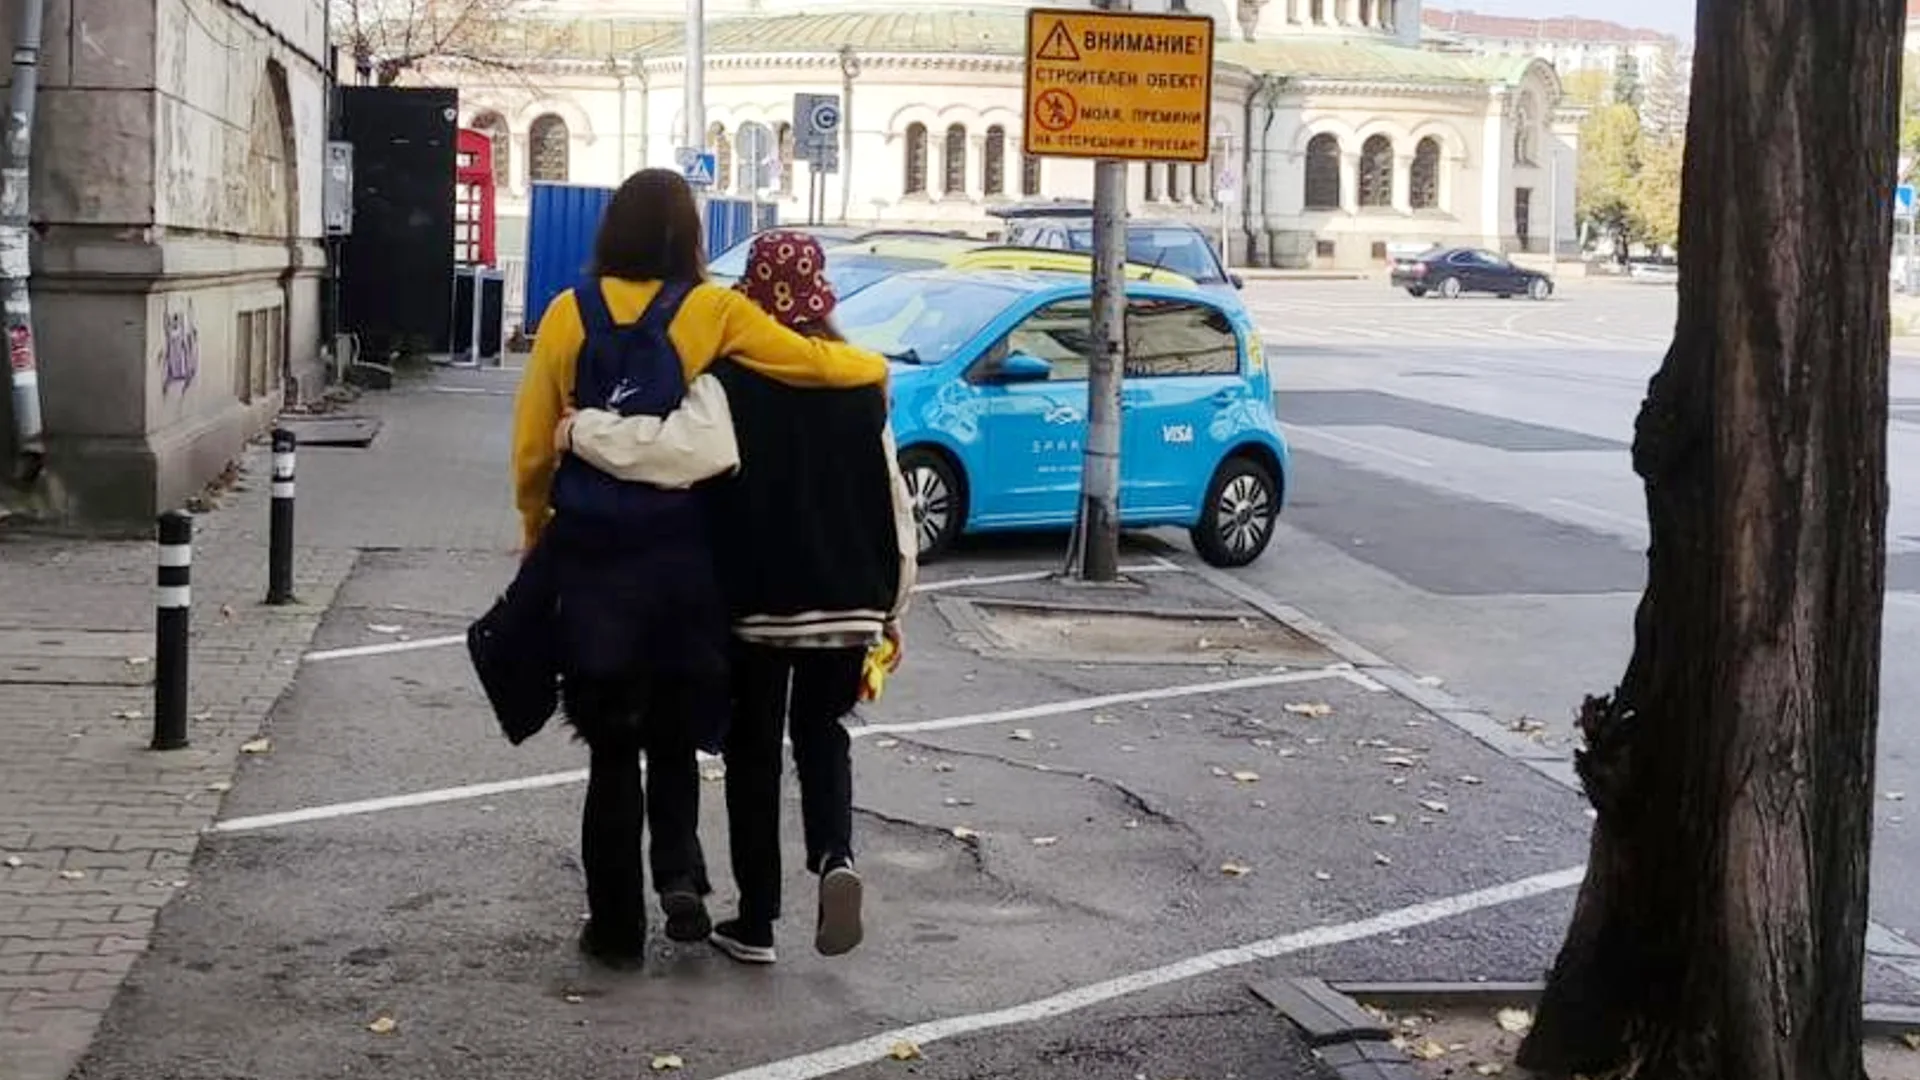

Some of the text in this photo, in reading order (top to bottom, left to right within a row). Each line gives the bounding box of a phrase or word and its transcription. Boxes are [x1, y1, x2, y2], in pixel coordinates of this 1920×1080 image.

[1084, 31, 1203, 55] ВНИМАНИЕ!
[1035, 68, 1138, 86] СТРОИТЕЛЕН
[1163, 424, 1193, 442] VISA
